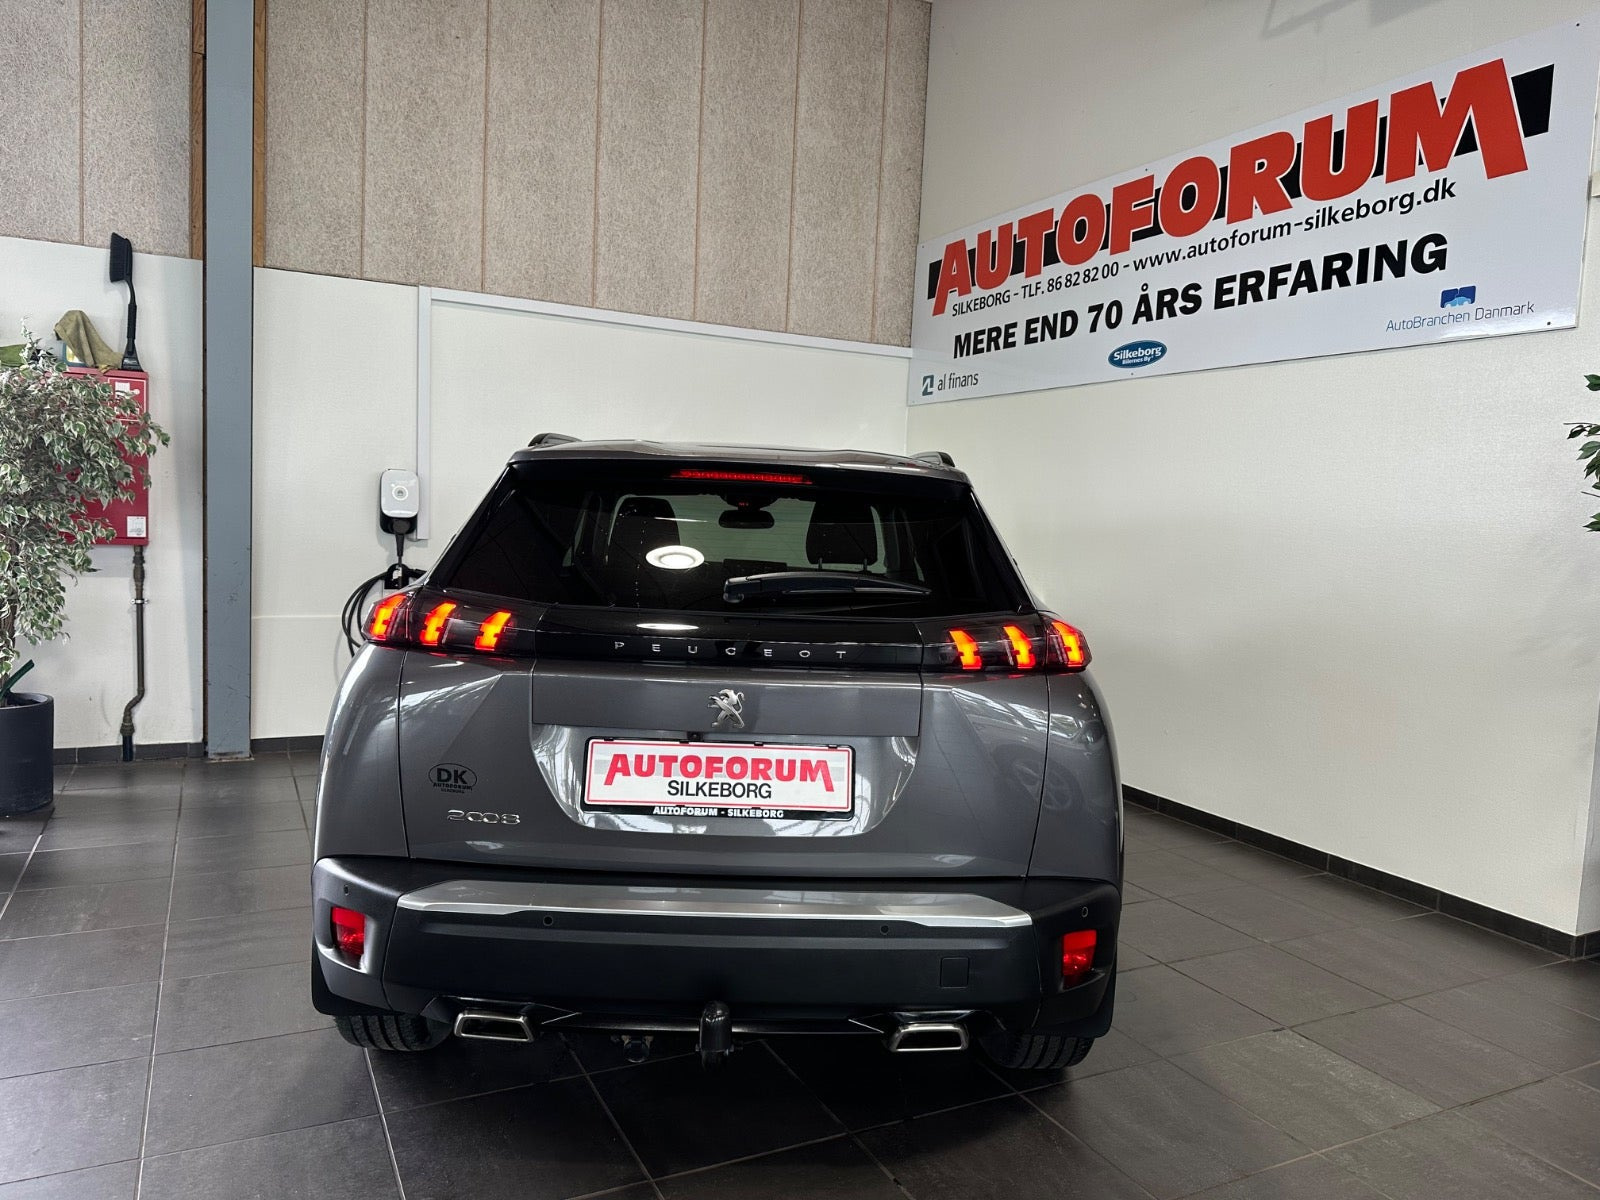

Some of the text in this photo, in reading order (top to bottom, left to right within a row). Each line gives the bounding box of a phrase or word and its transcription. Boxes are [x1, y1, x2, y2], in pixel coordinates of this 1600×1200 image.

[931, 57, 1528, 316] AUTOFORUM
[952, 290, 1010, 317] SILKEBORG
[1021, 281, 1044, 299] TLF.
[1132, 177, 1457, 272] www.autoforum-silkeborg.dk
[953, 232, 1448, 359] MERE END 70 ÅRS ERFARING
[1385, 301, 1535, 333] AutoBranchen Danmark
[1113, 346, 1162, 360] Silkeborg
[937, 372, 979, 391] al finans
[614, 641, 847, 659] PEUGEOT
[436, 767, 468, 785] DK
[604, 753, 835, 793] AUTOFORUM
[433, 782, 473, 791] AUTOFORUM
[667, 779, 772, 799] SILKEBORG
[447, 809, 521, 825] 2008
[653, 806, 718, 816] AUTOFORUM
[727, 809, 784, 818] SILKEBORG
